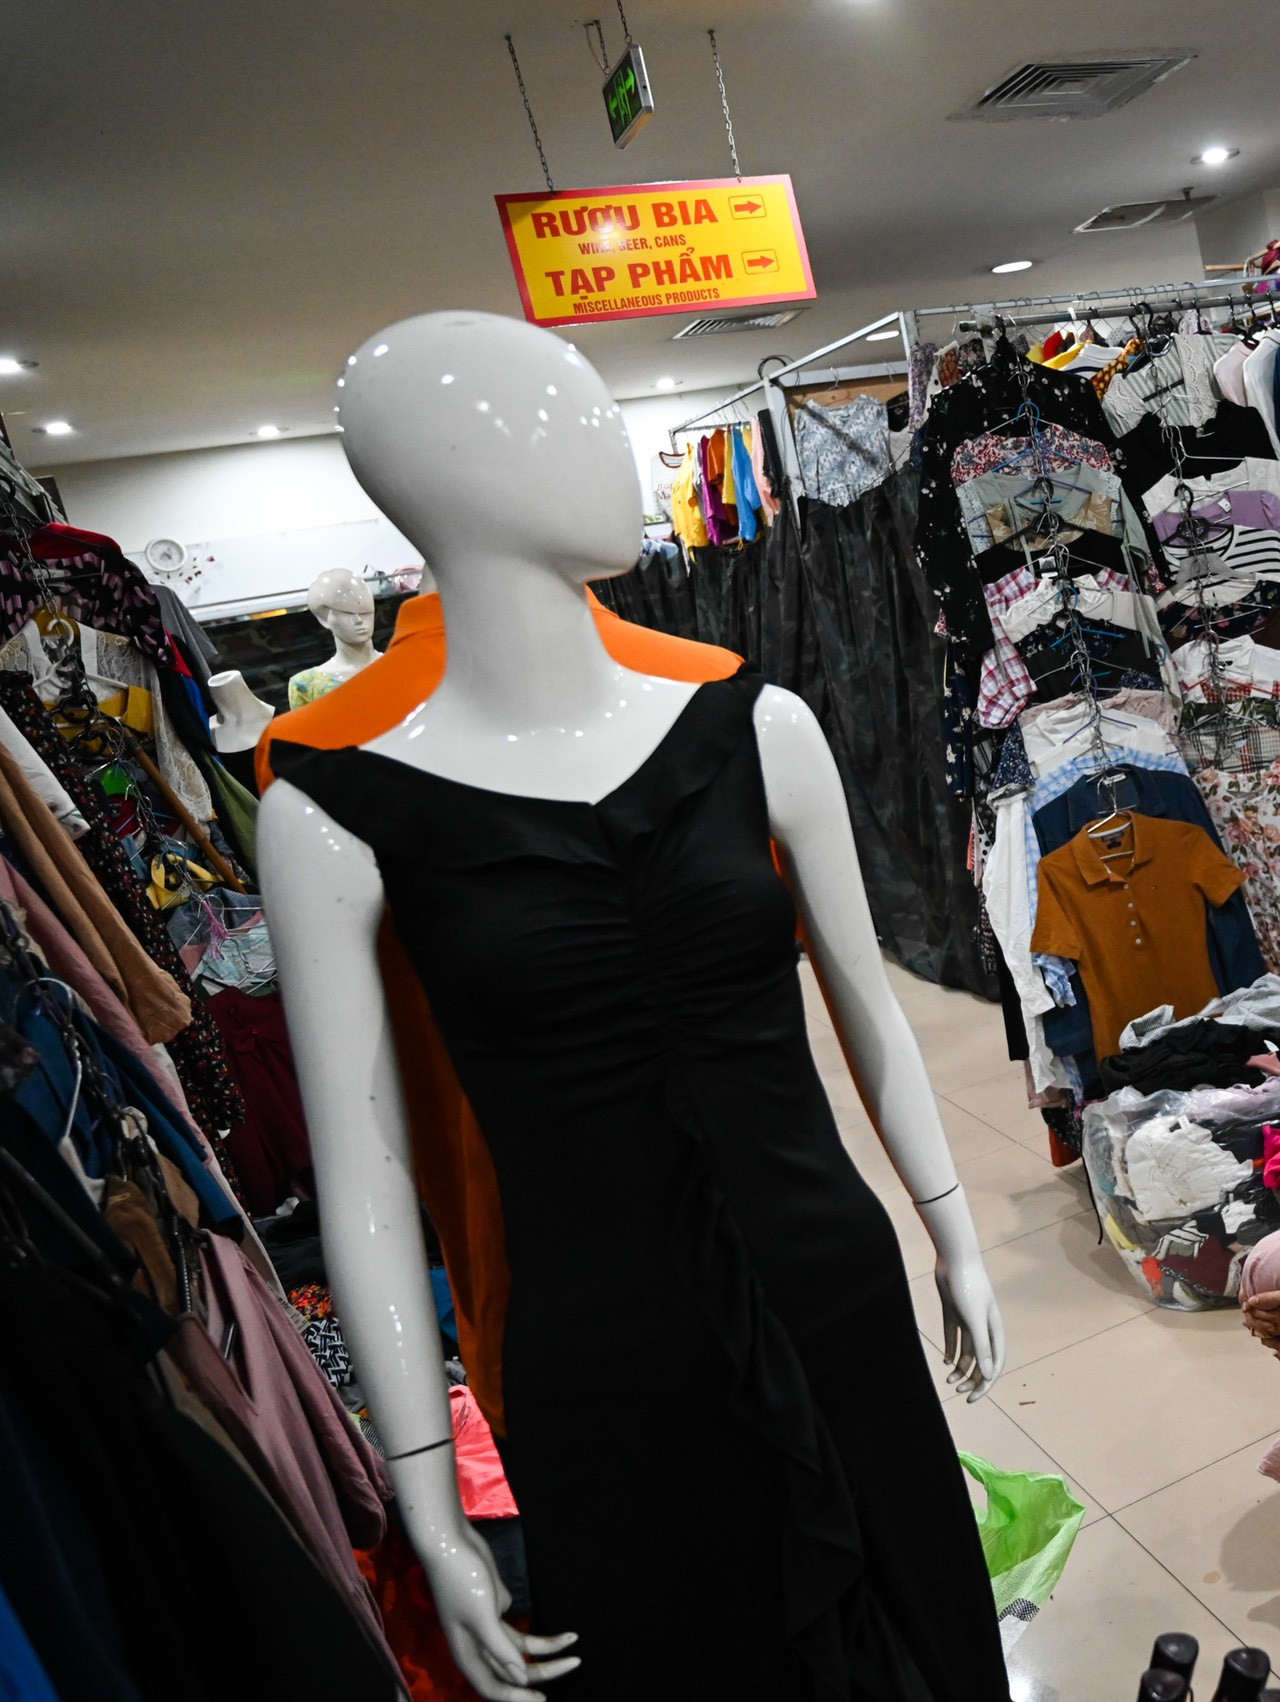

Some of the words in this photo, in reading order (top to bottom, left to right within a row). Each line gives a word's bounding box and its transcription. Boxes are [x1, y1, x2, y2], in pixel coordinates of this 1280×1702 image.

[652, 199, 718, 228] BIA
[619, 238, 652, 251] BEER,
[655, 234, 687, 248] CANS
[545, 266, 616, 300] TẠP
[627, 247, 733, 289] PHẨM
[573, 295, 662, 315] MISCELLANEOUS
[666, 288, 720, 305] PRODUCTS
